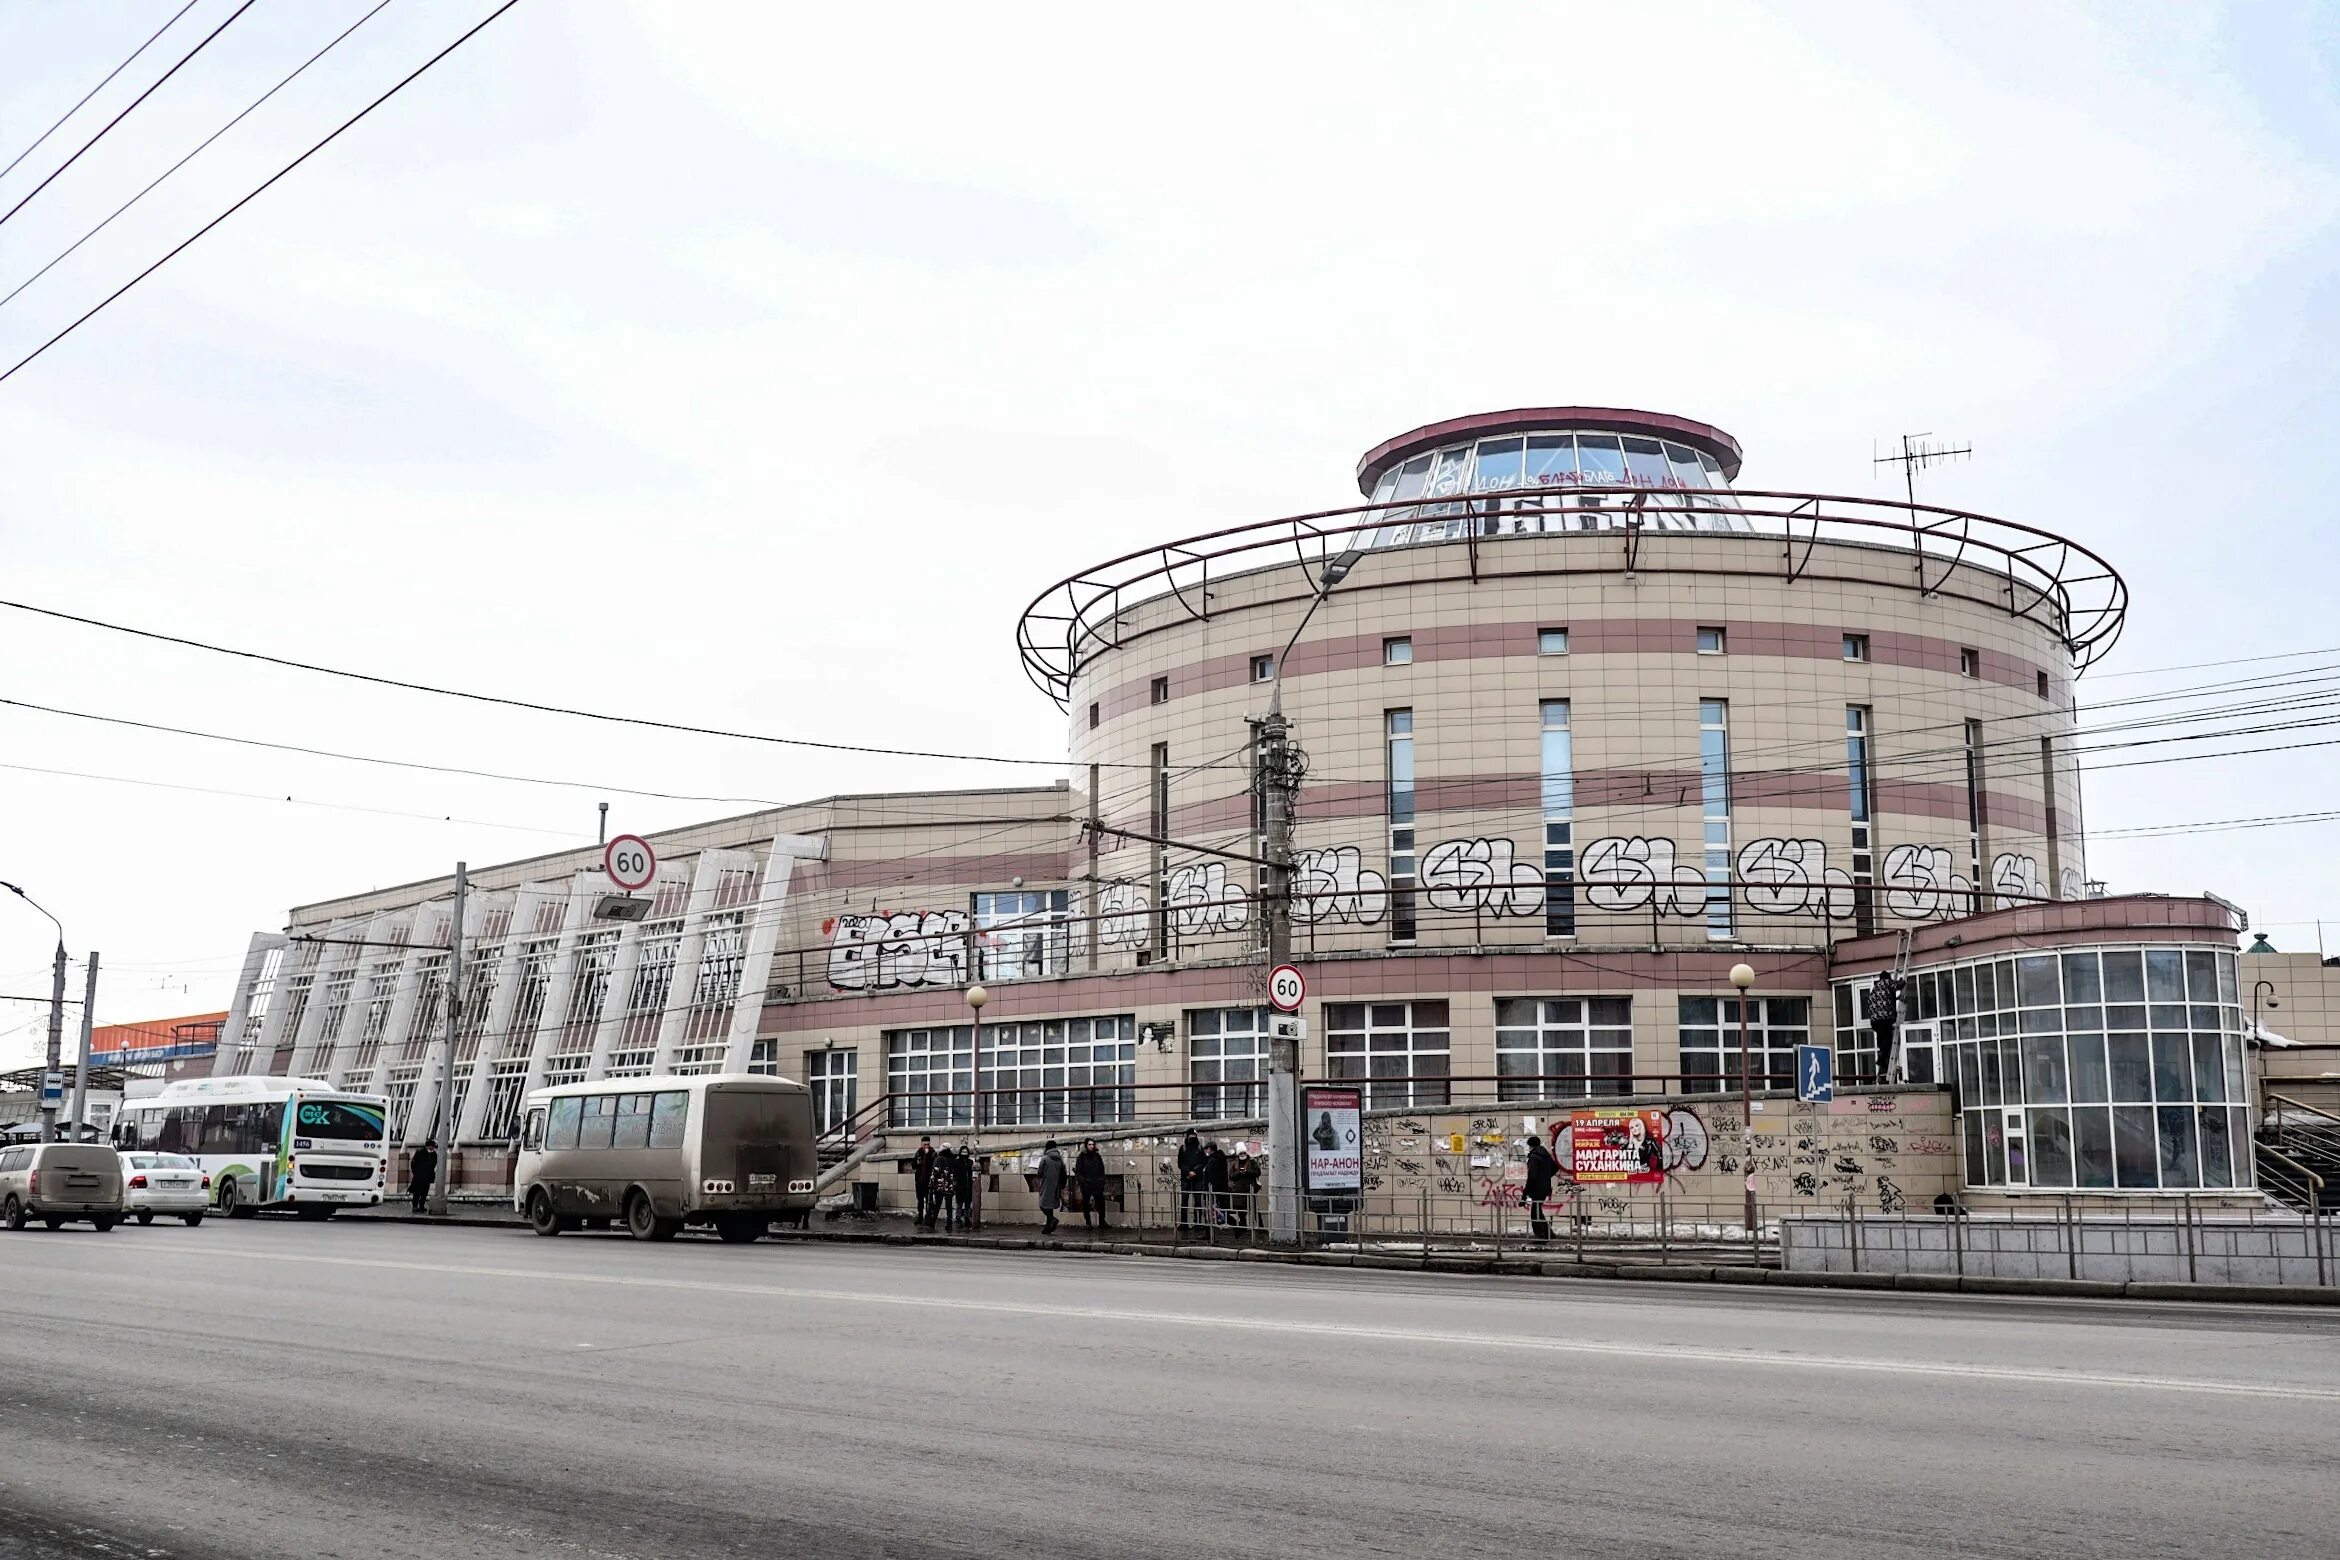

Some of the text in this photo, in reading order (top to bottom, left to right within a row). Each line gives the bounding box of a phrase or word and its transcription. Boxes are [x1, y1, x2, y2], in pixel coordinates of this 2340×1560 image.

[617, 852, 644, 873] 60
[842, 918, 868, 929] 2020
[1278, 979, 1297, 997] 60
[1575, 1119, 1620, 1127] 19 АПРЕЛЯ
[1576, 1150, 1640, 1160] МАРГАРИТА
[1310, 1157, 1359, 1169] НАР-АНОН
[1576, 1161, 1641, 1171] СУХАНКИНА
